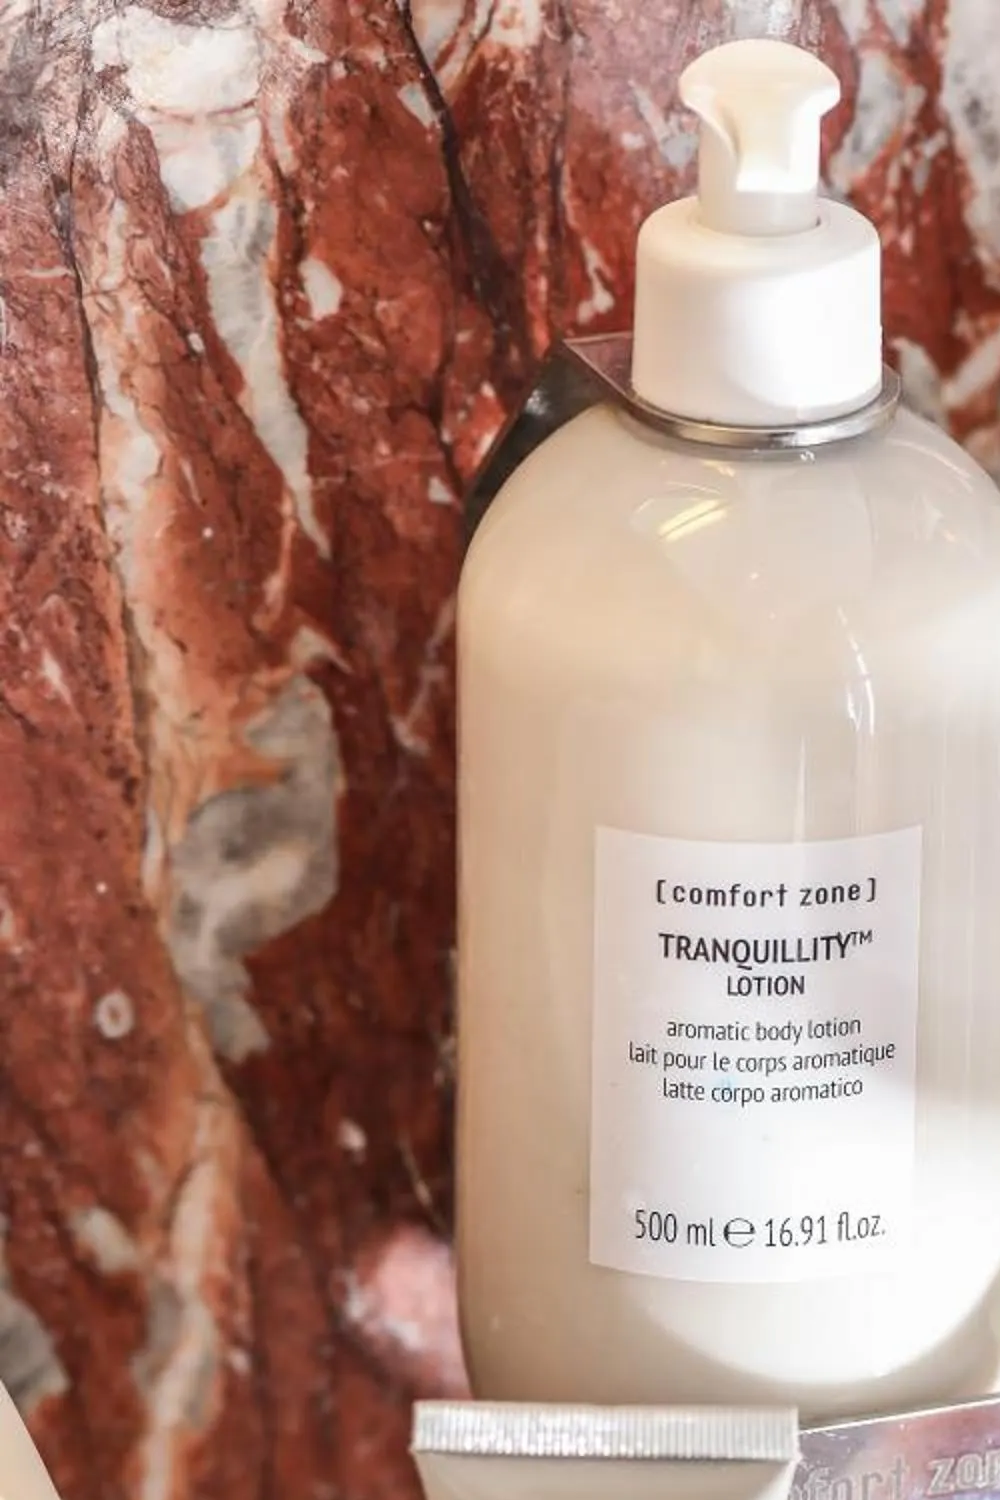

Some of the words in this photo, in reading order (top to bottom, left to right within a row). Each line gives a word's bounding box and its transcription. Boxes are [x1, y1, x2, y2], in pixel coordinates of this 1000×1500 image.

[727, 975, 805, 996] LOTION
[666, 1019, 750, 1042] aromatic
[755, 1021, 803, 1045] body
[807, 1017, 862, 1039] lotion
[628, 1041, 658, 1065] lait
[663, 1048, 707, 1073] pour
[713, 1046, 731, 1072] le
[735, 1052, 787, 1076] corps
[793, 1042, 897, 1071] aromatique
[662, 1078, 706, 1101] latte
[710, 1082, 765, 1108] corpo
[771, 1078, 863, 1103] aromatico
[634, 1210, 678, 1243] 500
[687, 1218, 716, 1247] ml
[764, 1215, 828, 1248] 16.91
